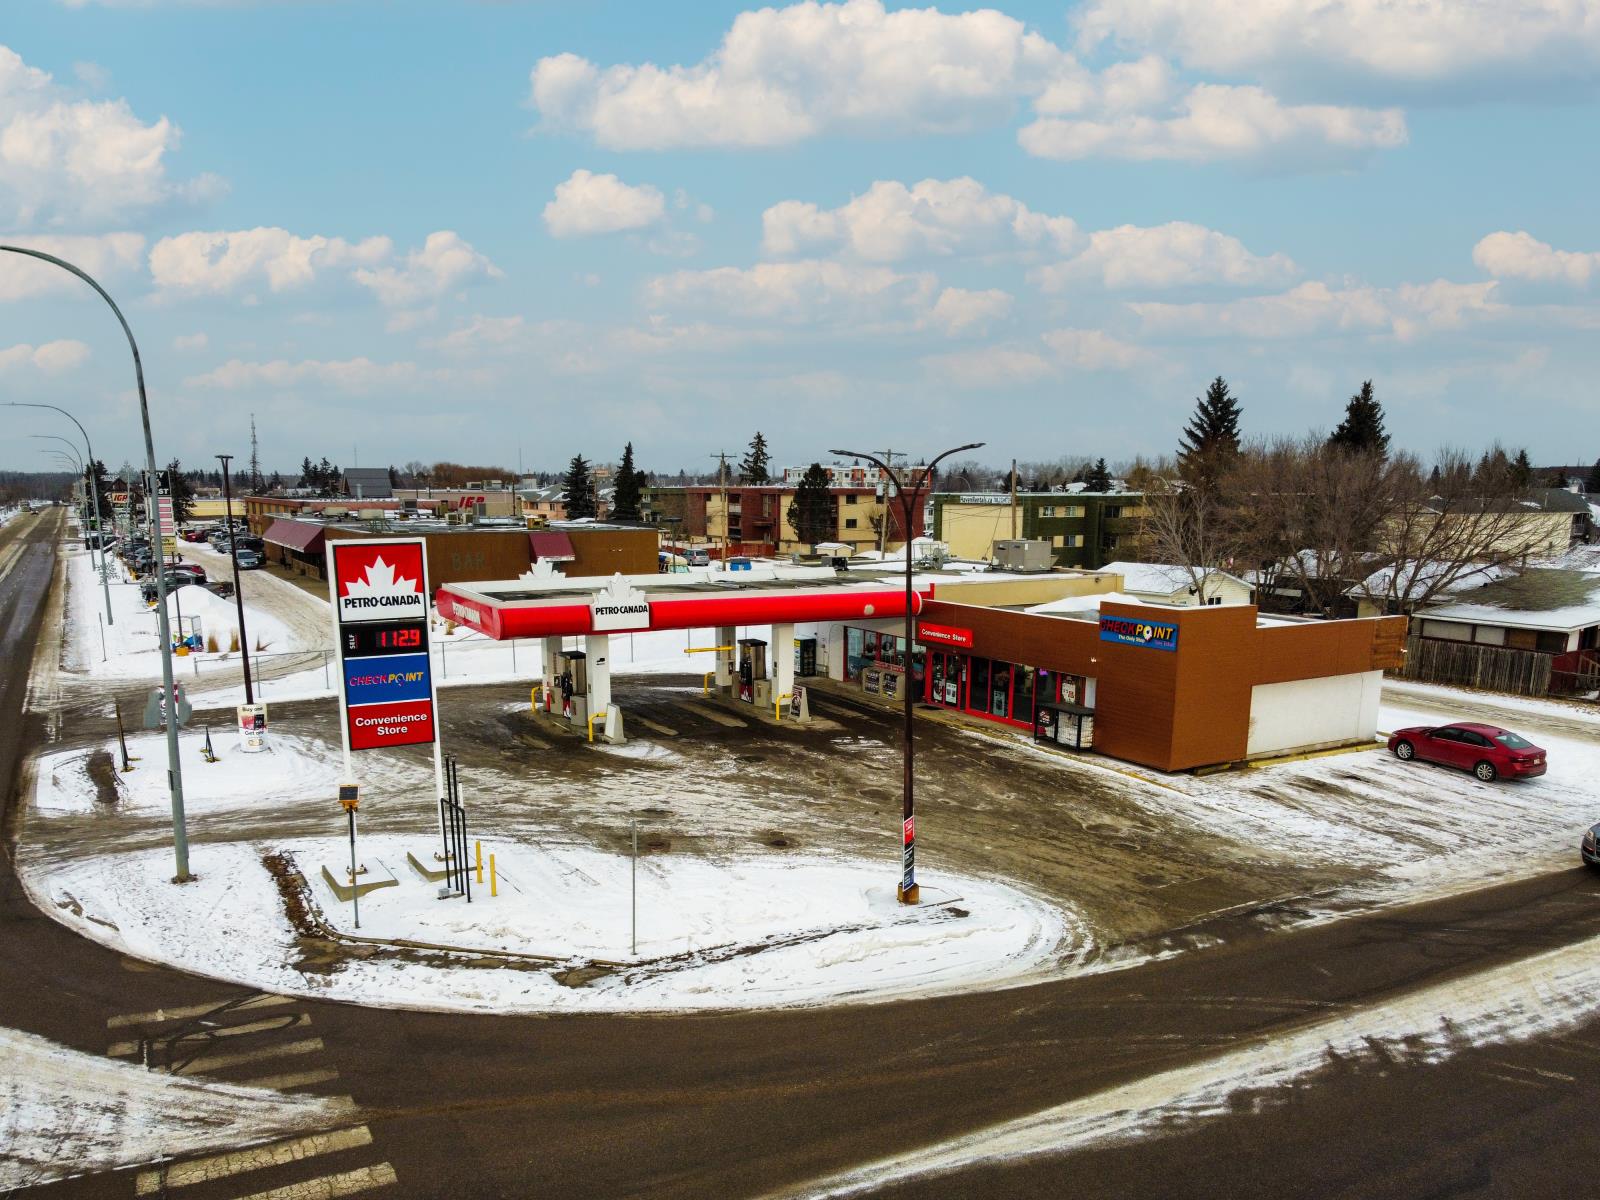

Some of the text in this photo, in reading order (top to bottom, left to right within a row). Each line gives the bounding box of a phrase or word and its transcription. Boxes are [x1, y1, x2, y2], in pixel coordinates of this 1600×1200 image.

[348, 634, 356, 650] SELF
[921, 628, 967, 643] Convenience Store
[355, 713, 428, 727] Convenience
[377, 726, 408, 736] Store
